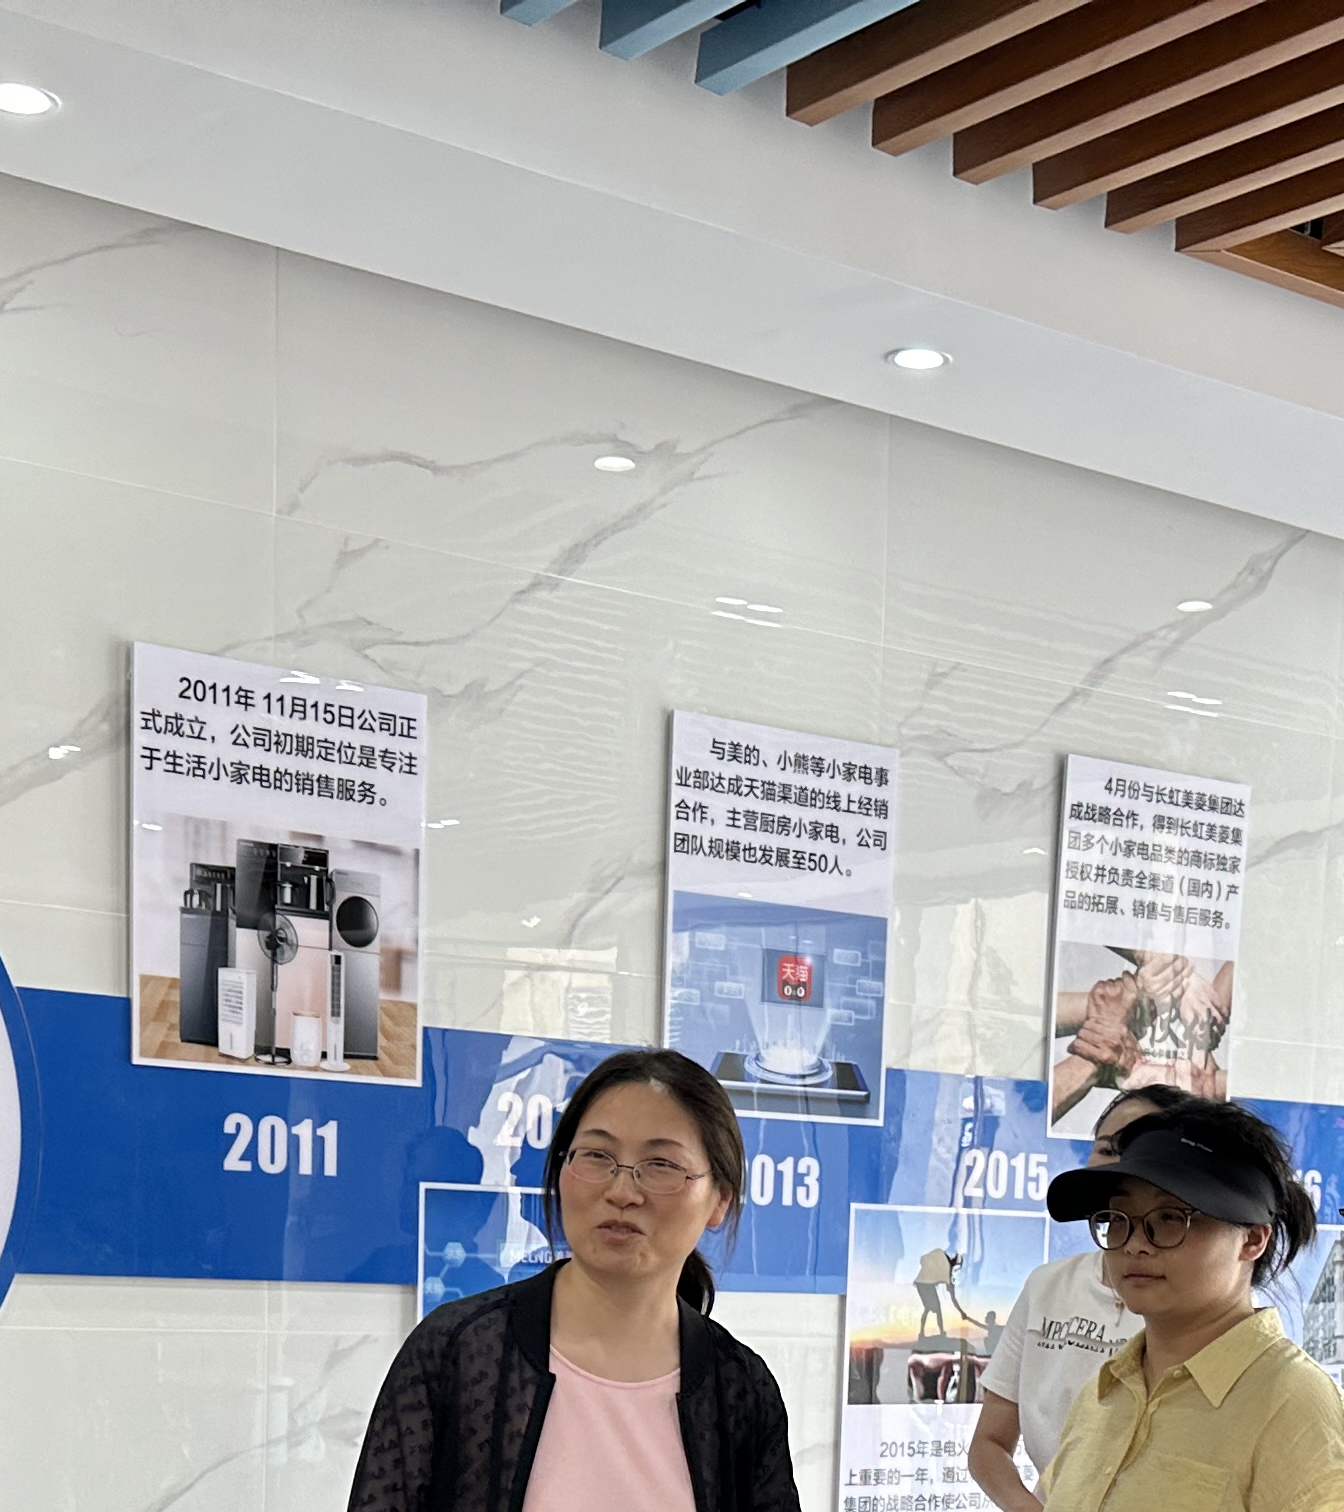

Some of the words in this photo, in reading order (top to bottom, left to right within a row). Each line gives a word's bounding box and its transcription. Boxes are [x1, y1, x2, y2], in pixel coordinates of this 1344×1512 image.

[178, 676, 256, 711] 2011年
[263, 692, 418, 739] 11月15日公司正
[140, 707, 418, 776] 式成立，公司初期定位是专注
[709, 737, 890, 787] 与美的、小熊等小家电事
[140, 745, 388, 807] 于生活小家电的销售服务。
[674, 798, 888, 851] 合作，主营厨房小家电，公司
[673, 832, 852, 878] 团队规模也发展至50人。
[222, 1112, 339, 1177] 2011
[744, 1154, 820, 1208] 013
[964, 1149, 1049, 1201] 2015
